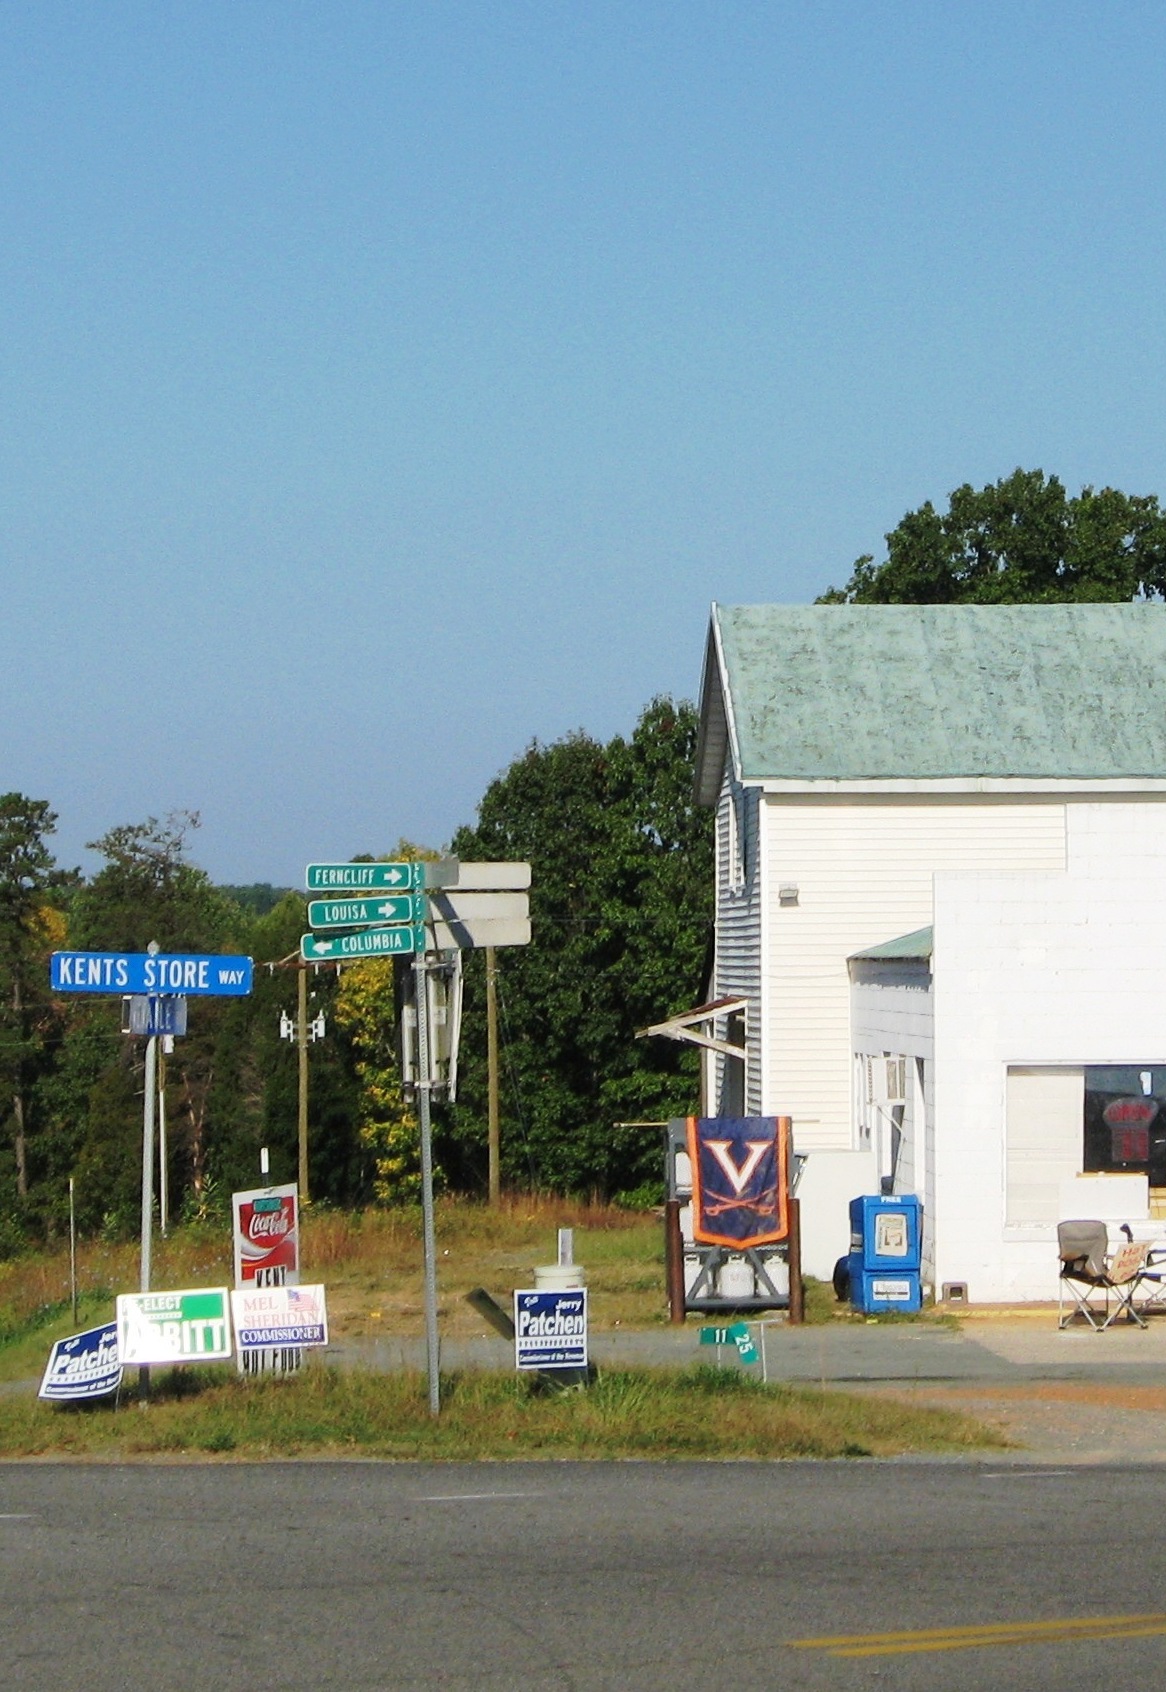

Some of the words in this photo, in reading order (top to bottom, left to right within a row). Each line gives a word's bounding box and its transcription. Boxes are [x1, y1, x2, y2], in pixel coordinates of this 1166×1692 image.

[315, 869, 375, 885] FERNCLIFF
[325, 904, 368, 921] LOUISA
[342, 933, 402, 952] COLUMBIA
[59, 957, 128, 986] KENTS
[144, 959, 210, 988] STORE
[218, 970, 245, 985] WAY
[244, 1296, 278, 1311] MEL
[555, 1300, 582, 1312] Jerry
[244, 1312, 319, 1328] SHERIDAN
[520, 1310, 584, 1336] Patchen
[241, 1326, 321, 1344] COMMISSIONER
[51, 1344, 118, 1375] Patche
